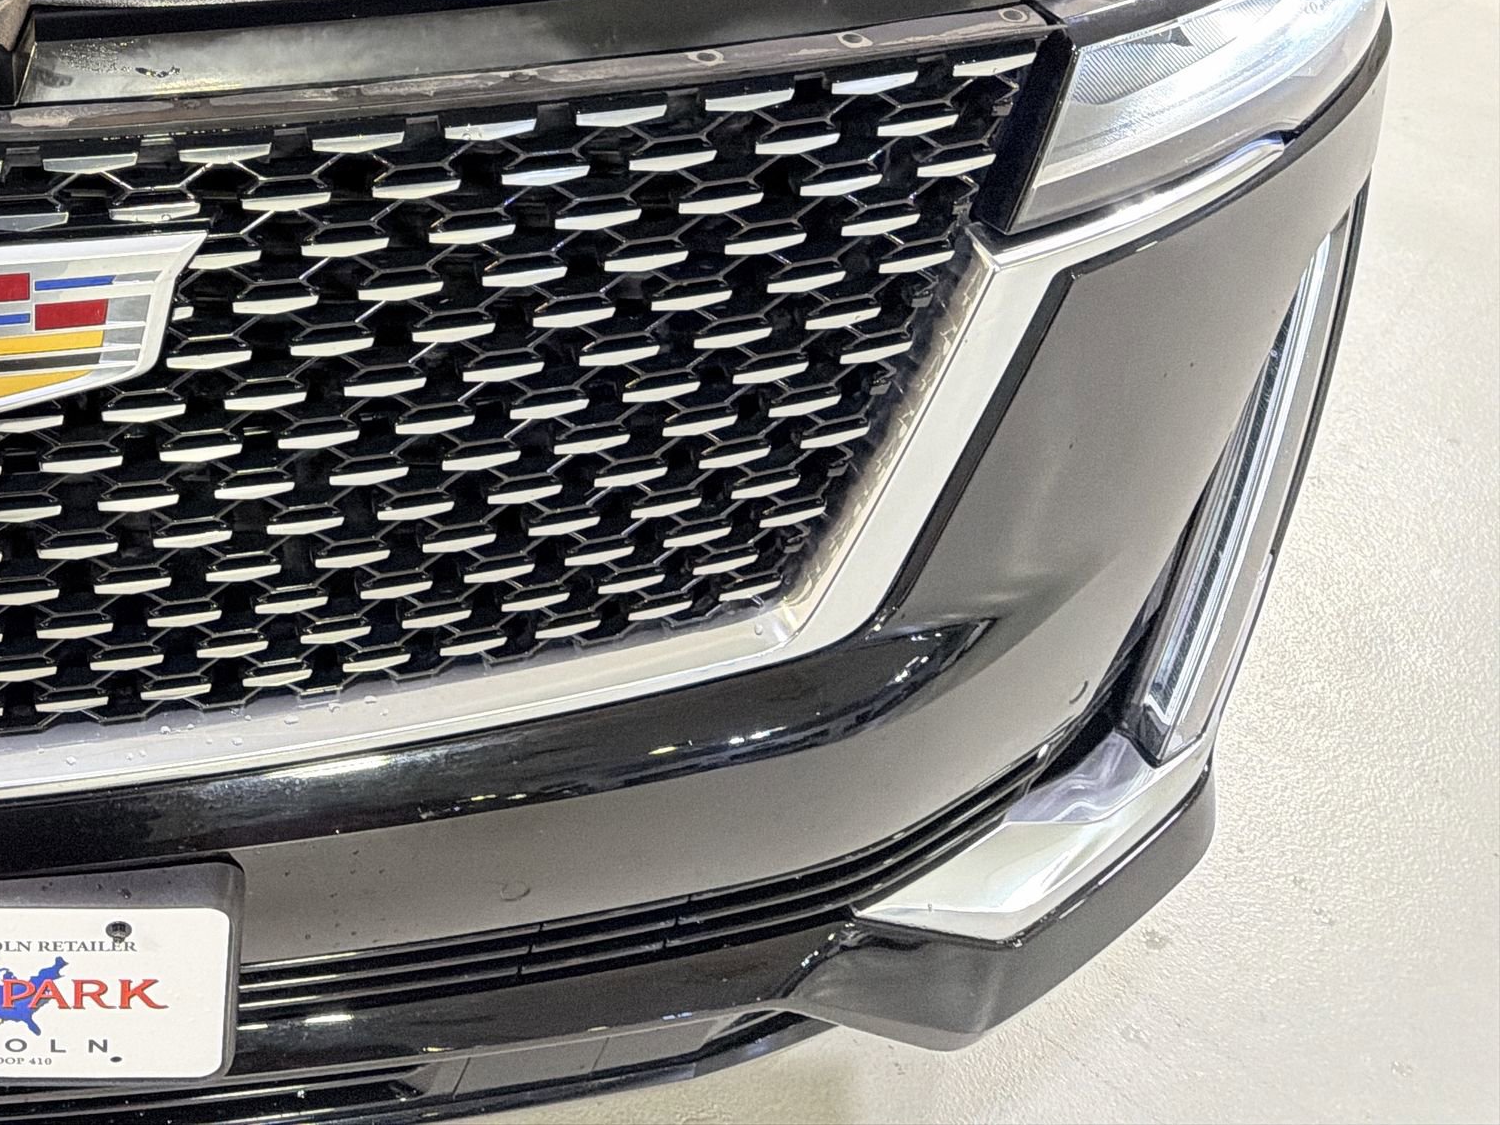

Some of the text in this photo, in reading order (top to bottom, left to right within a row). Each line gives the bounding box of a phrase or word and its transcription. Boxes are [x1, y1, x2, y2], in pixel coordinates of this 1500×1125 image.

[38, 940, 137, 953] RETAILER
[1, 978, 169, 1010] PARK
[29, 1057, 52, 1066] 410
